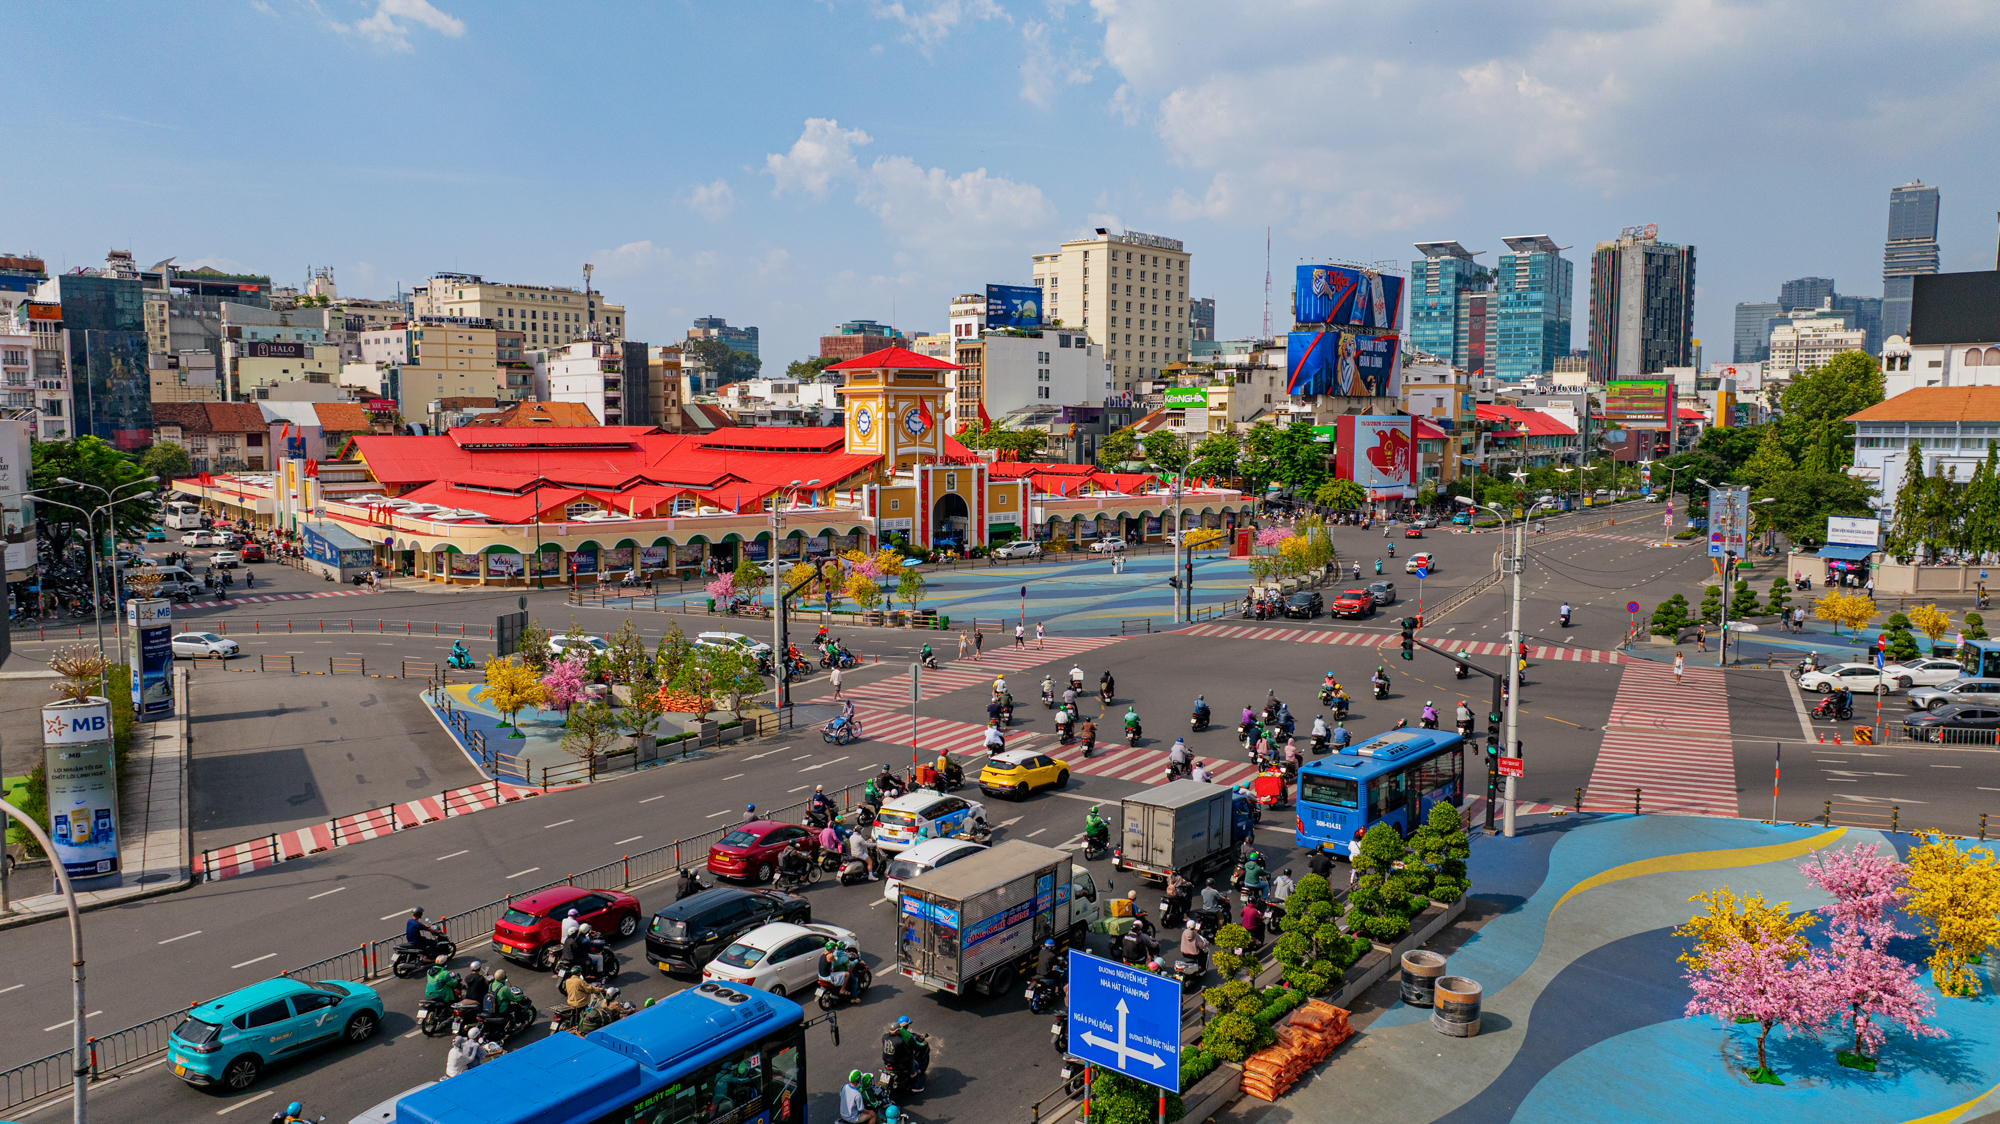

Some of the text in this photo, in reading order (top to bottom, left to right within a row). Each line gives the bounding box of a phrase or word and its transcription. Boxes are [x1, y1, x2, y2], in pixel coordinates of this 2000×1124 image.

[1327, 271, 1350, 292] Tiger
[923, 455, 937, 464] CHỢ
[492, 555, 510, 565] Vikki
[157, 607, 170, 618] MB
[72, 716, 105, 732] MB
[966, 930, 986, 944] CÔNG
[987, 919, 1005, 934] NGHỆ
[1007, 909, 1029, 925] OZONE
[1098, 965, 1148, 987] ĐƯỜNG NGUYỄN HUỆ
[1100, 978, 1150, 1000] NHÀ HÁT THÀNH PHỐ
[1073, 1012, 1083, 1023] NGÃ
[1088, 1017, 1098, 1027] PHÙ
[1129, 1032, 1176, 1054] ĐƯỜNG TÔN ĐỨC THẮNG
[751, 1055, 759, 1066] 31
[634, 1101, 644, 1113] XE
[645, 1091, 664, 1107] BUÝT
